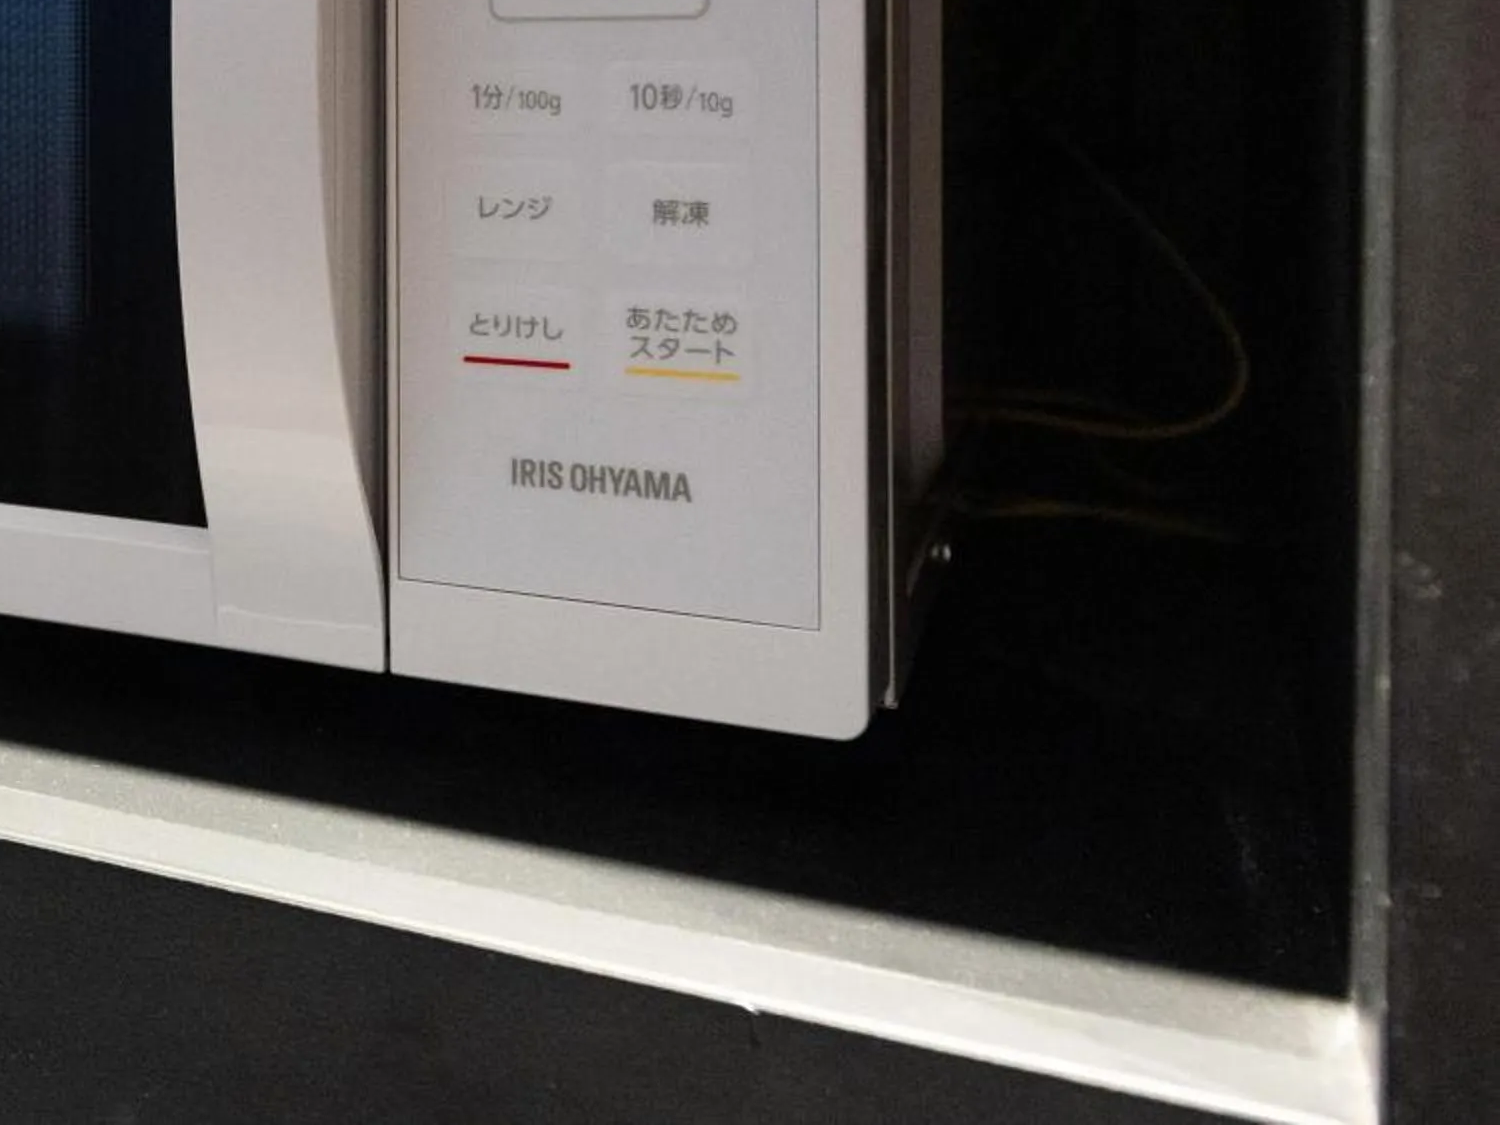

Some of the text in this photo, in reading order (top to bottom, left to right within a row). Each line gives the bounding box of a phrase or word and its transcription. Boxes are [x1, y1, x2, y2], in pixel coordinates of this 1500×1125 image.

[478, 195, 552, 221] レンジ
[652, 198, 710, 228] 解凍
[468, 312, 564, 341] とりけし
[625, 306, 738, 335] あたため
[630, 336, 735, 364] スタート
[511, 457, 693, 504] IRIS OHYAMA
